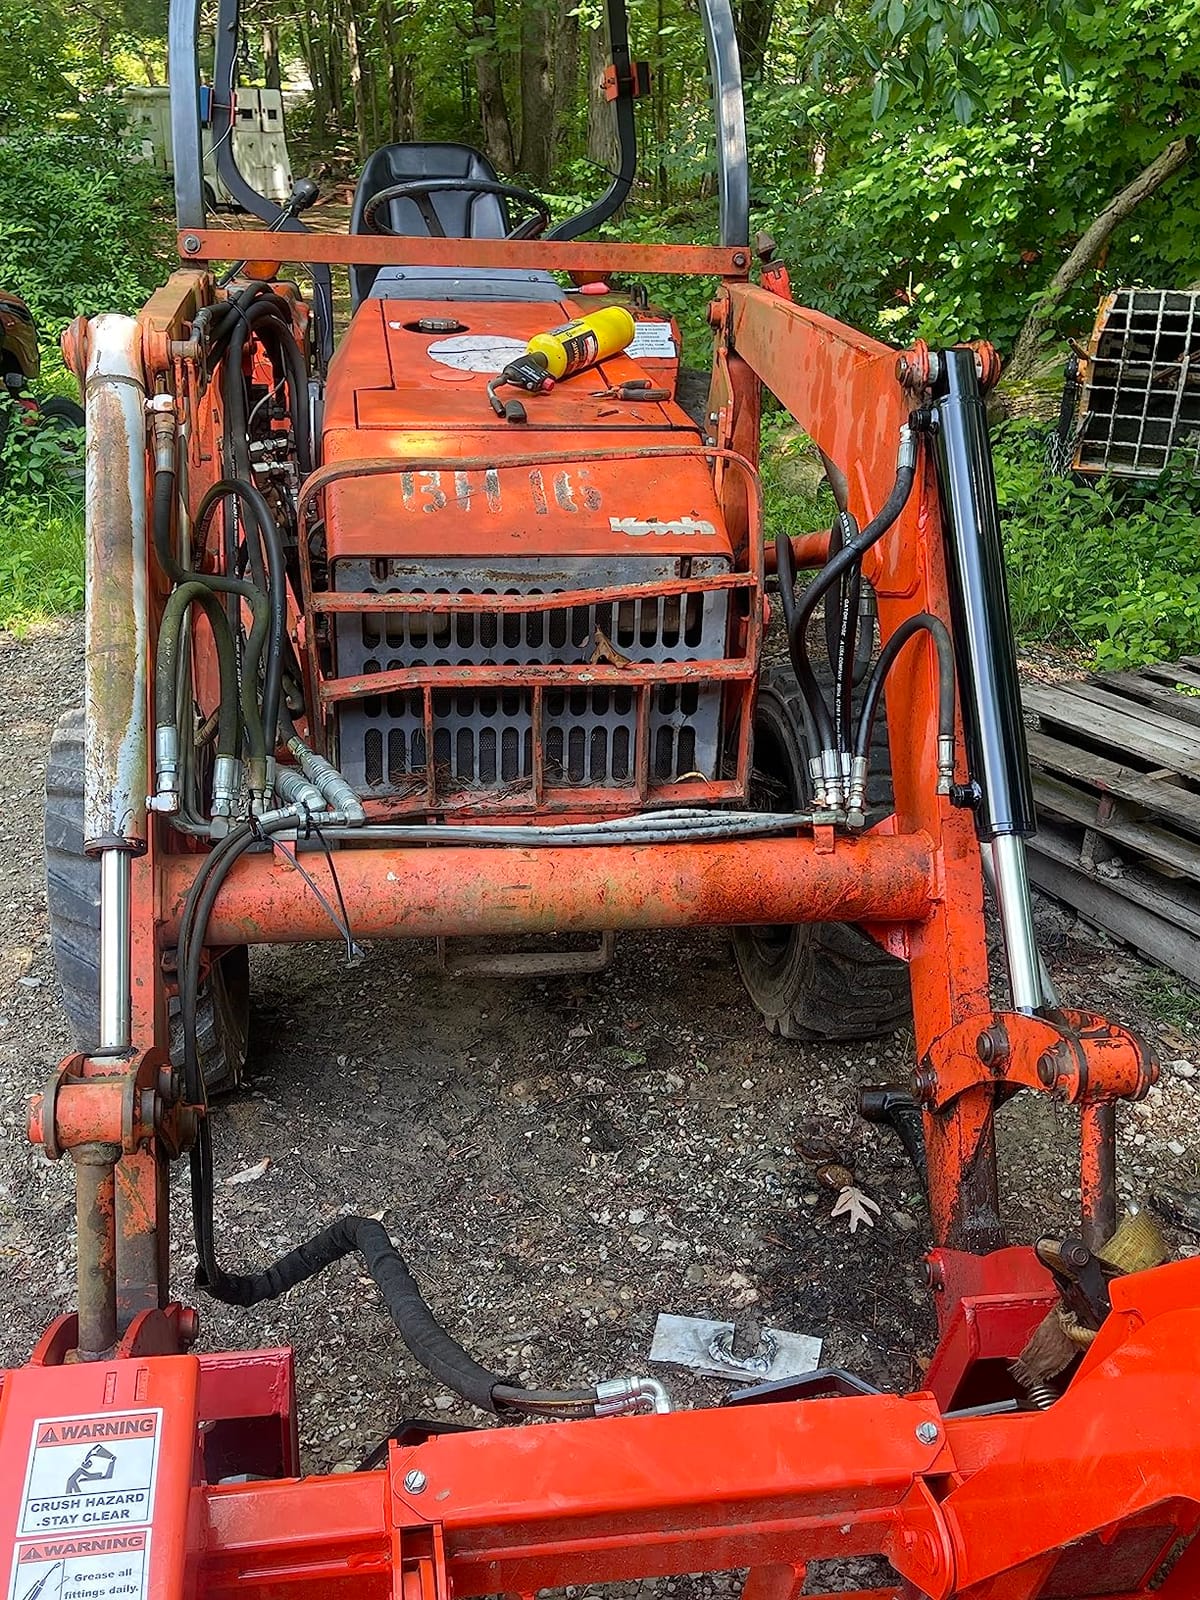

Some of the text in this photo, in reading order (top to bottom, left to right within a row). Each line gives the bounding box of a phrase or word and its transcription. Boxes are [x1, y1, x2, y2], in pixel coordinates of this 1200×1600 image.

[61, 1418, 154, 1440] WARNING
[30, 1493, 145, 1513] CRUSH HAZARD
[82, 1509, 130, 1523] CLEAR
[43, 1536, 143, 1557] WARNING
[74, 1568, 132, 1582] Grease all
[64, 1584, 139, 1600] fittings daily.
